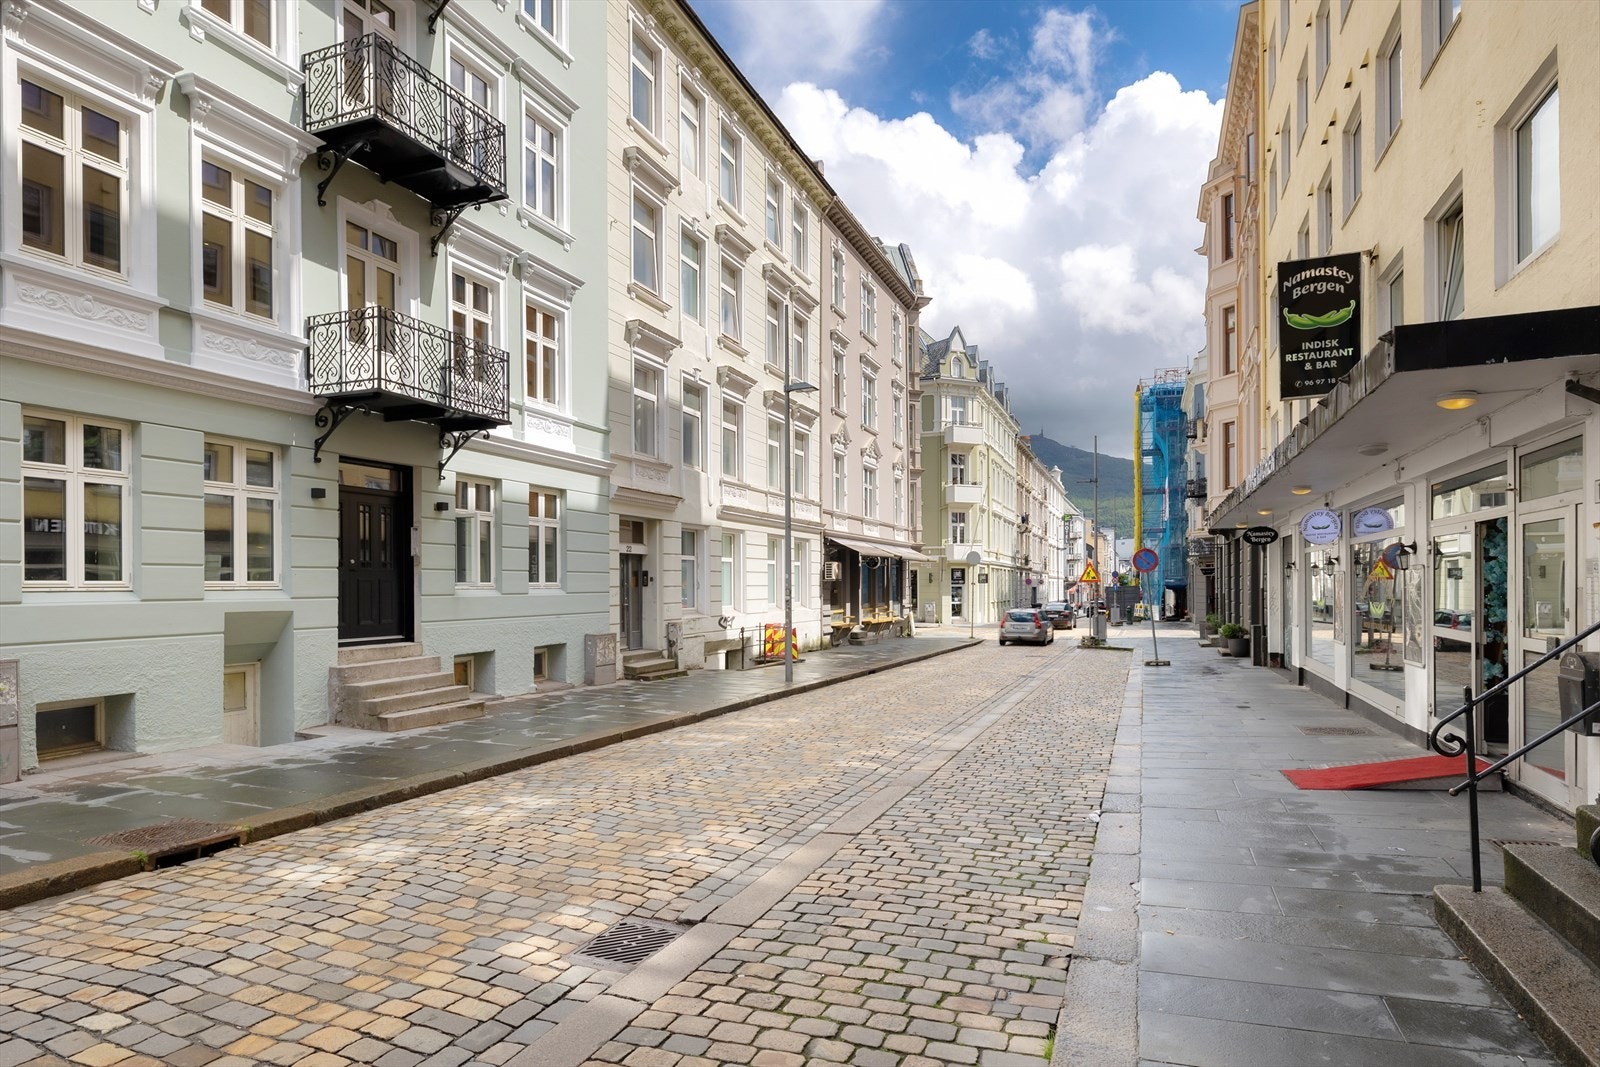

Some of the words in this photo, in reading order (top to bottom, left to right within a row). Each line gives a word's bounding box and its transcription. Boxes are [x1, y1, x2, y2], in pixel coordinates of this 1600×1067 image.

[1283, 265, 1354, 292] Namastey
[1292, 281, 1345, 300] Bergen
[1302, 339, 1339, 350] INDISK
[1285, 348, 1354, 362] RESTAURANT
[1304, 362, 1312, 371] &
[1316, 360, 1337, 370] BAR
[1325, 511, 1339, 530] Bergen
